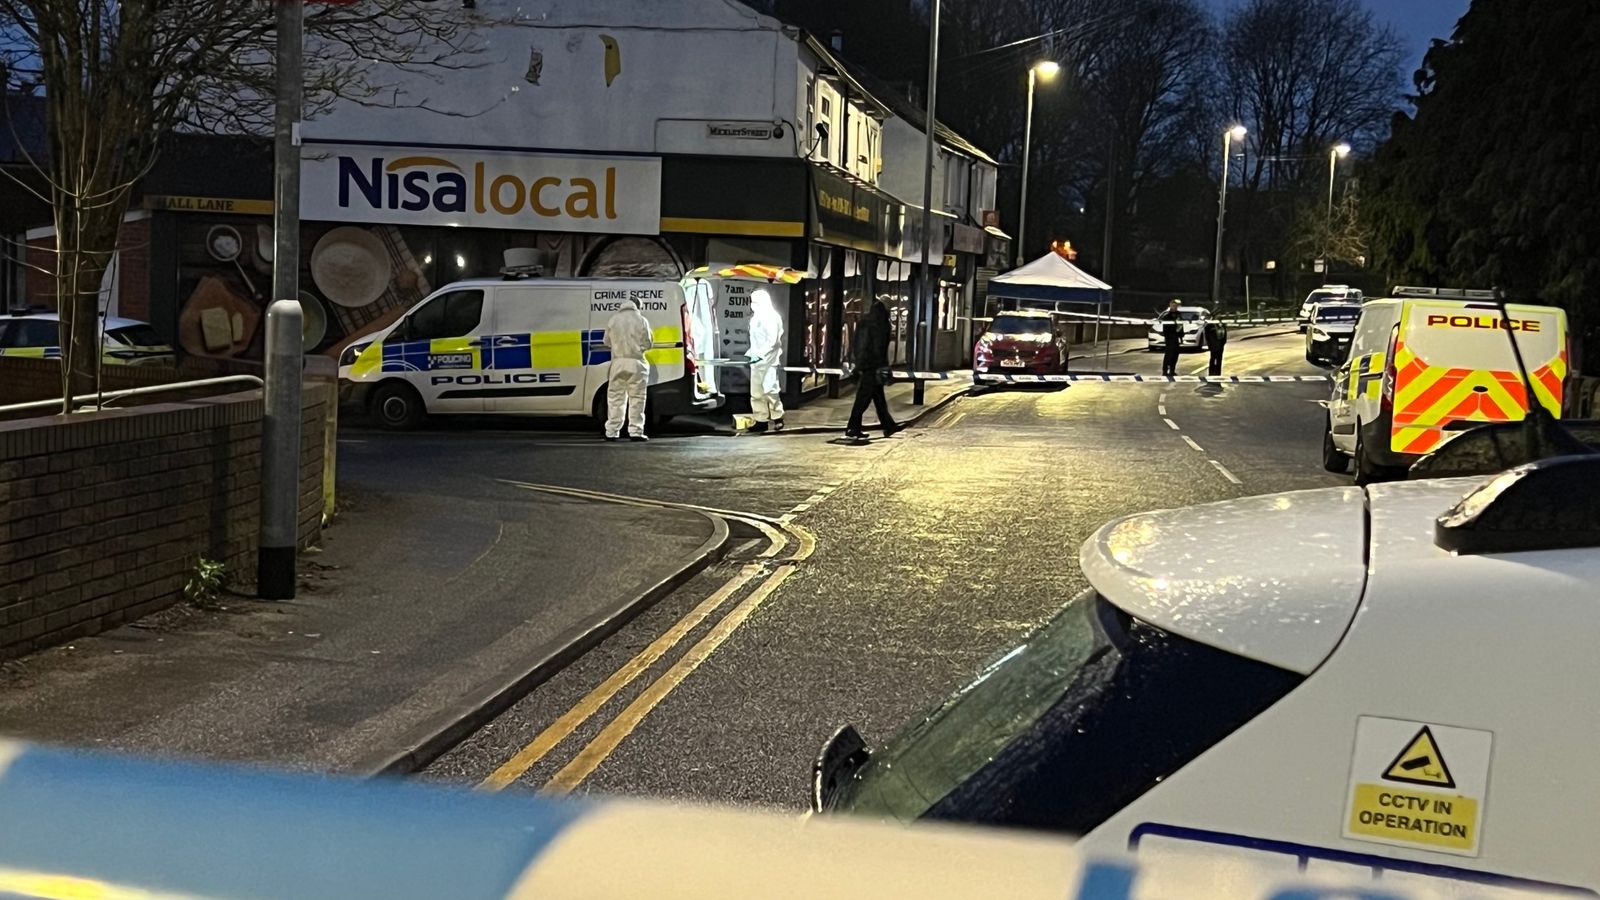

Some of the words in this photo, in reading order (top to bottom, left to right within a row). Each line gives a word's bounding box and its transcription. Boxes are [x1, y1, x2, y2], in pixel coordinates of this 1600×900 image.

[197, 199, 234, 211] LANE
[594, 290, 627, 300] CRIME
[630, 290, 664, 299] SCENE
[725, 284, 744, 294] 7am
[591, 302, 667, 311] INVESTION
[724, 309, 744, 318] 9am
[1427, 315, 1540, 332] POLICE
[431, 373, 560, 385] POLICE
[1378, 792, 1429, 811] CCTV
[1433, 800, 1452, 815] IN
[1359, 810, 1467, 838] OPERATION
